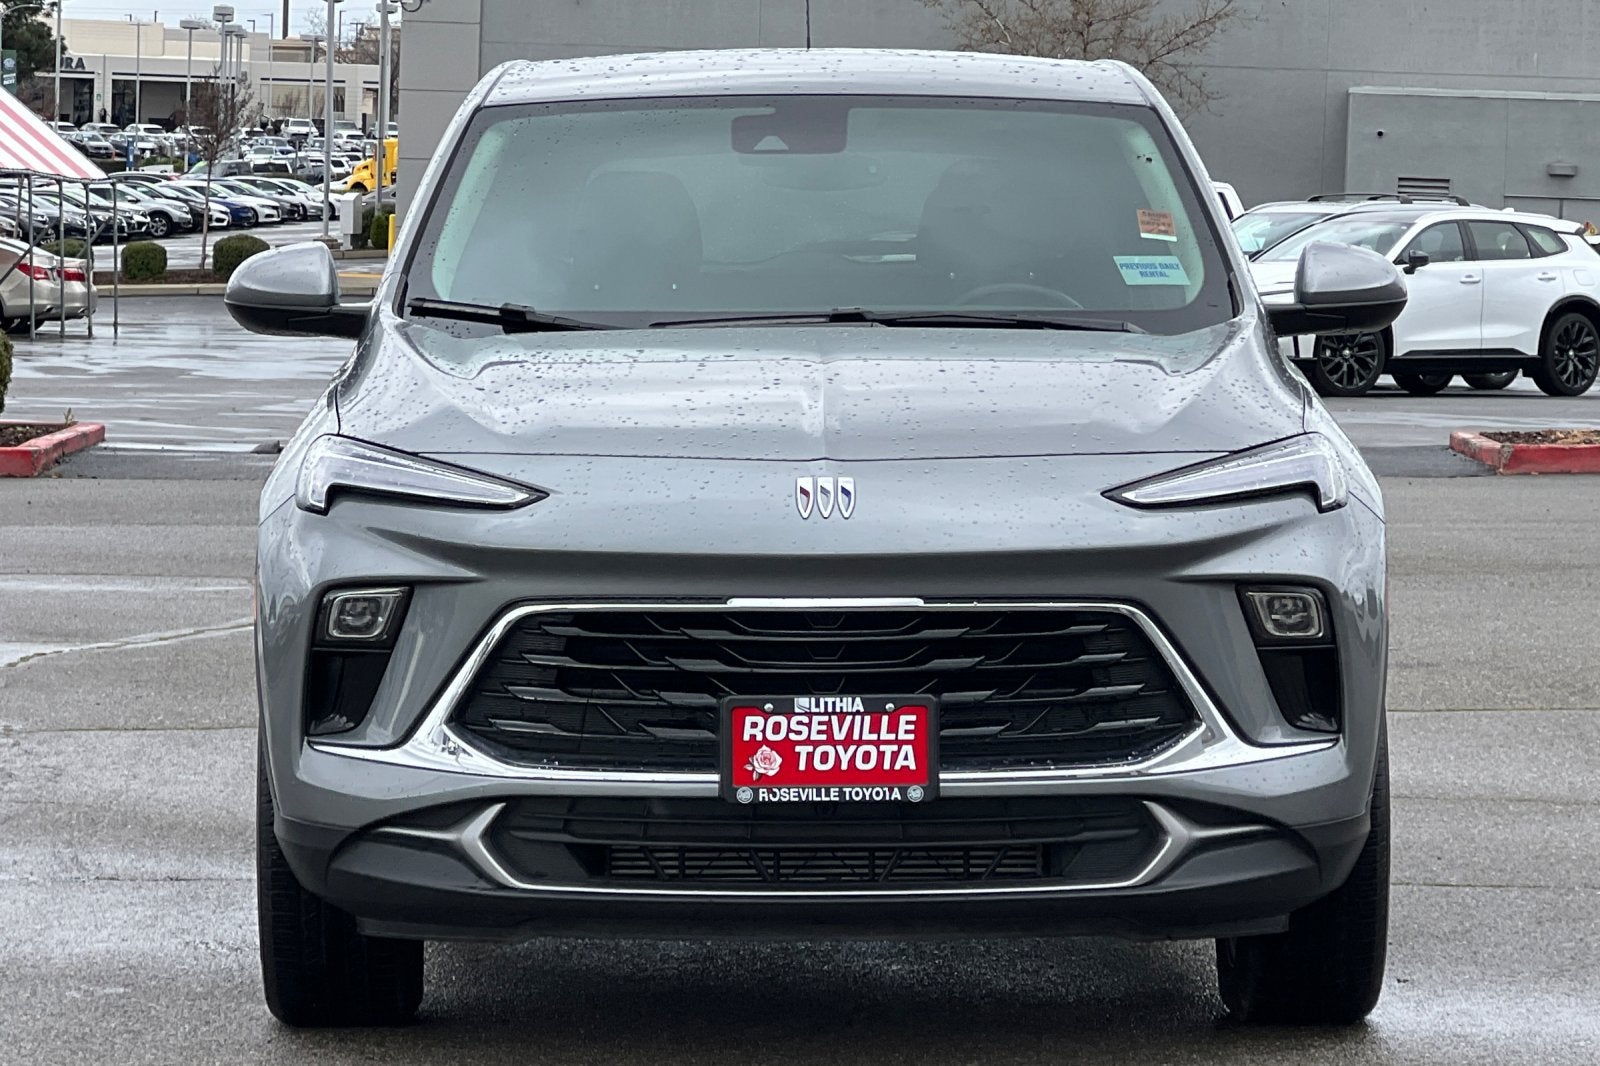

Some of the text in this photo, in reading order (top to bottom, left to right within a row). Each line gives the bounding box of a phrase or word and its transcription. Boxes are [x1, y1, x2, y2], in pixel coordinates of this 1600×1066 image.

[810, 697, 864, 713] LITHIA
[742, 715, 917, 742] ROSEVILLE
[794, 744, 917, 771] TOYOTA
[758, 787, 902, 801] ROSEVILLE TOYOTA
